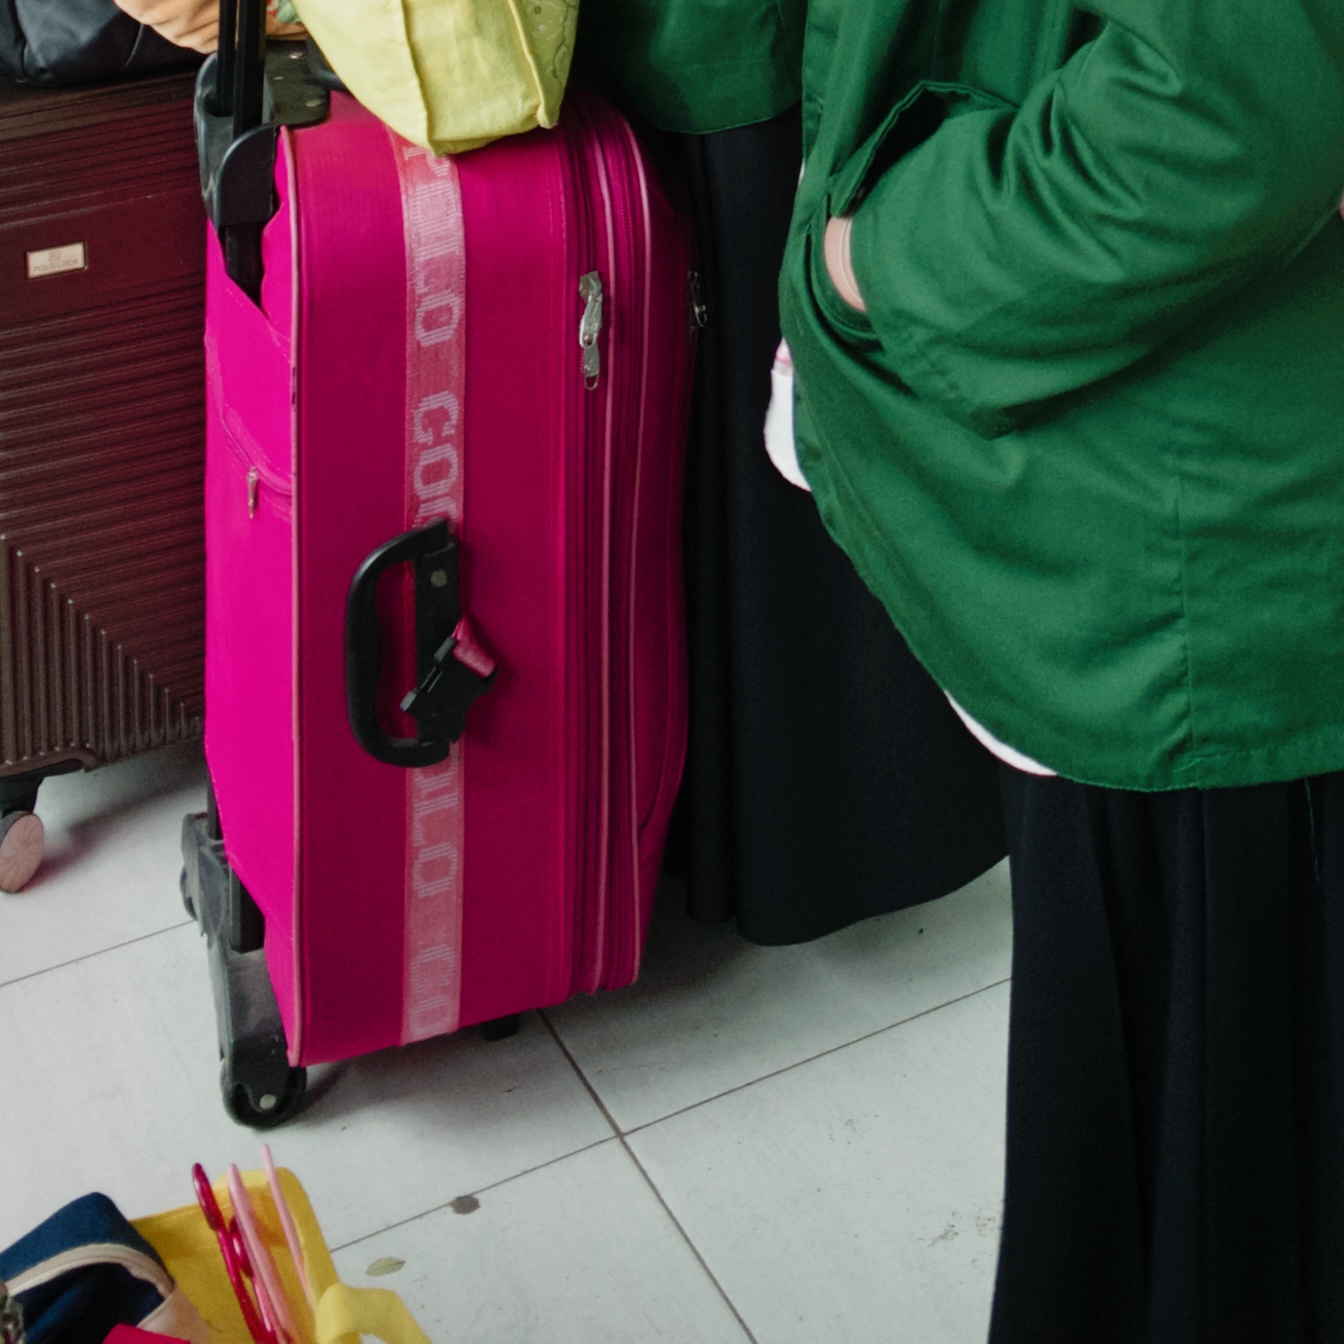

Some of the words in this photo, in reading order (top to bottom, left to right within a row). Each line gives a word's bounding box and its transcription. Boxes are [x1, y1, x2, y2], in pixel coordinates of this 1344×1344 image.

[33, 263, 56, 273] POLO
[56, 258, 79, 269] LOCK
[412, 744, 459, 899] OLO
